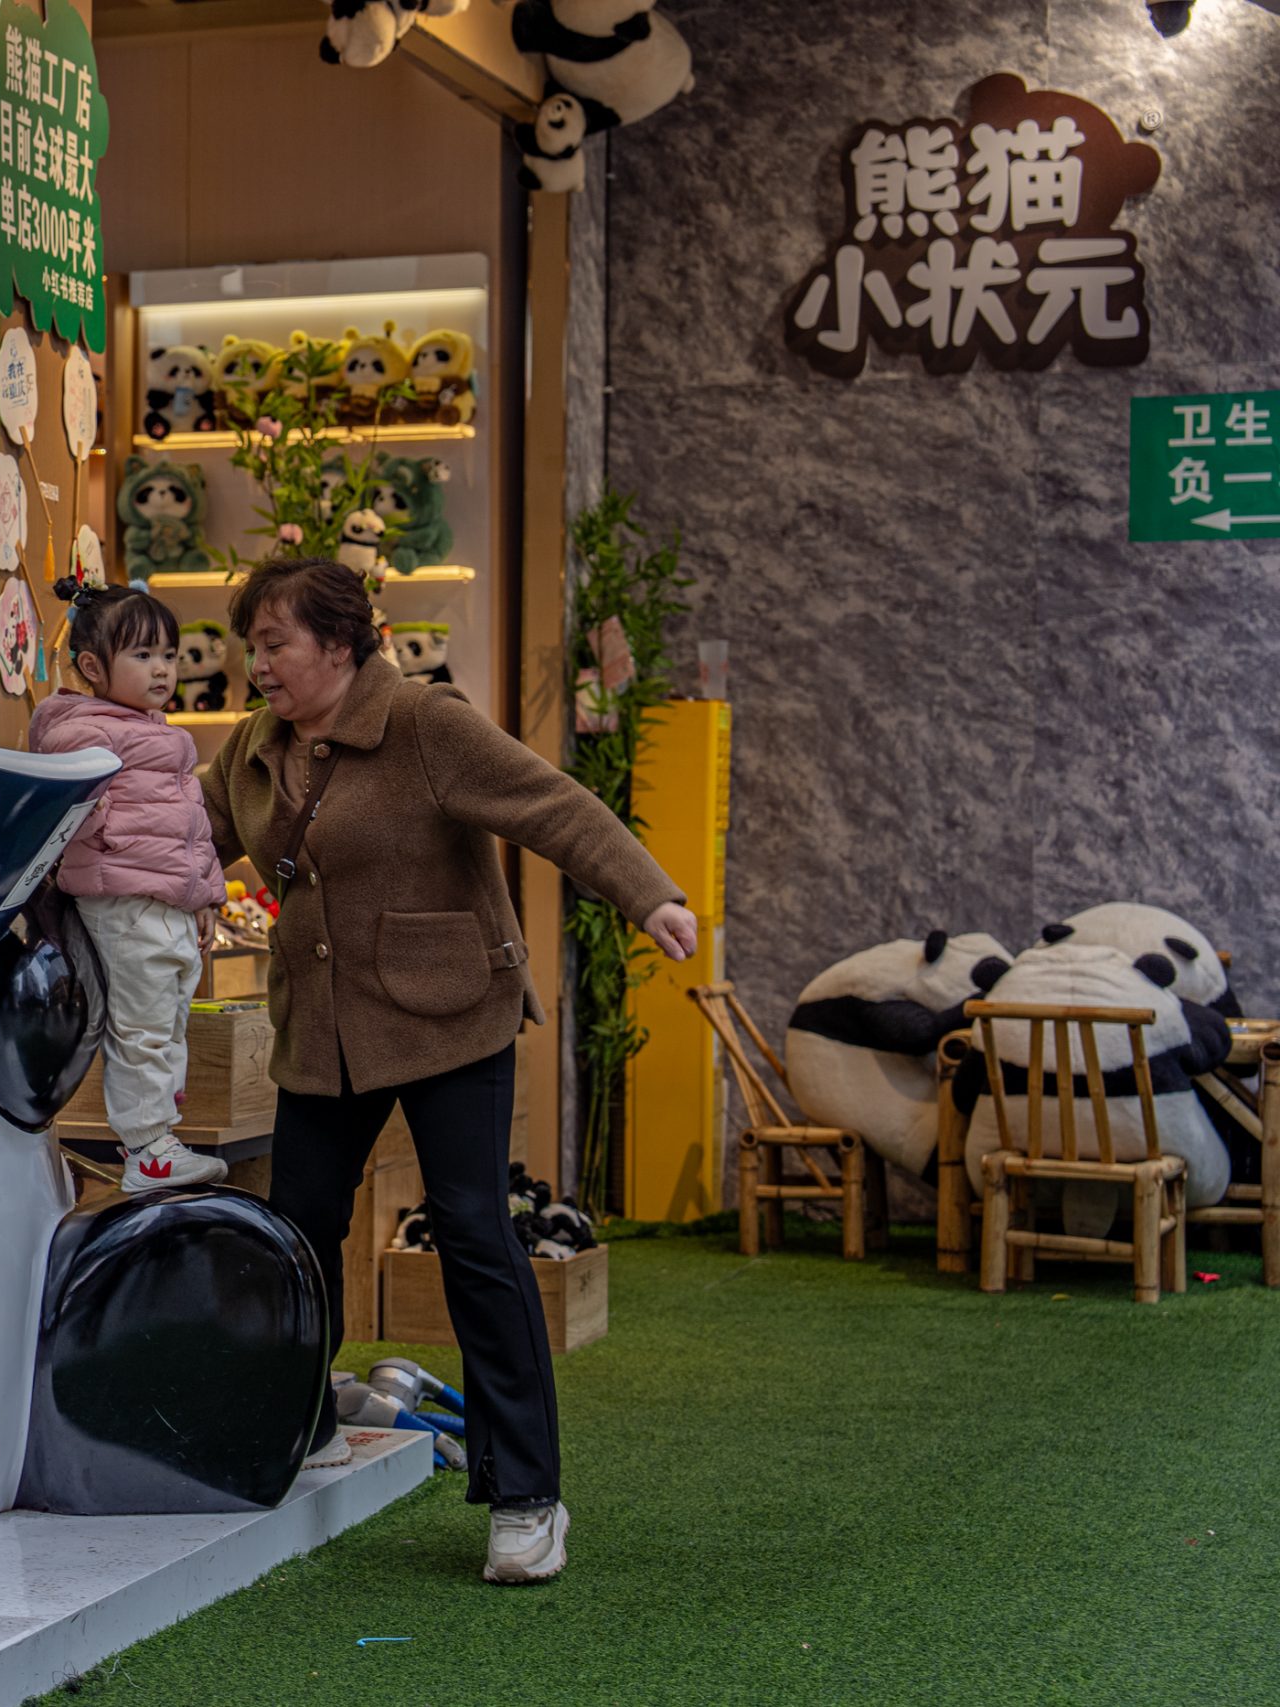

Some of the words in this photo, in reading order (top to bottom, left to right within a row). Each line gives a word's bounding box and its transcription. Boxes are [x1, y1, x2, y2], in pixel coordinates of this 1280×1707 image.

[5, 24, 92, 131] 熊猫工厂店
[0, 100, 94, 205] 目前全球最大
[850, 115, 1086, 242] 熊猫
[0, 177, 96, 279] 单店3000平米
[42, 265, 94, 312] 小红书推荐店
[793, 237, 1140, 353] 小状元
